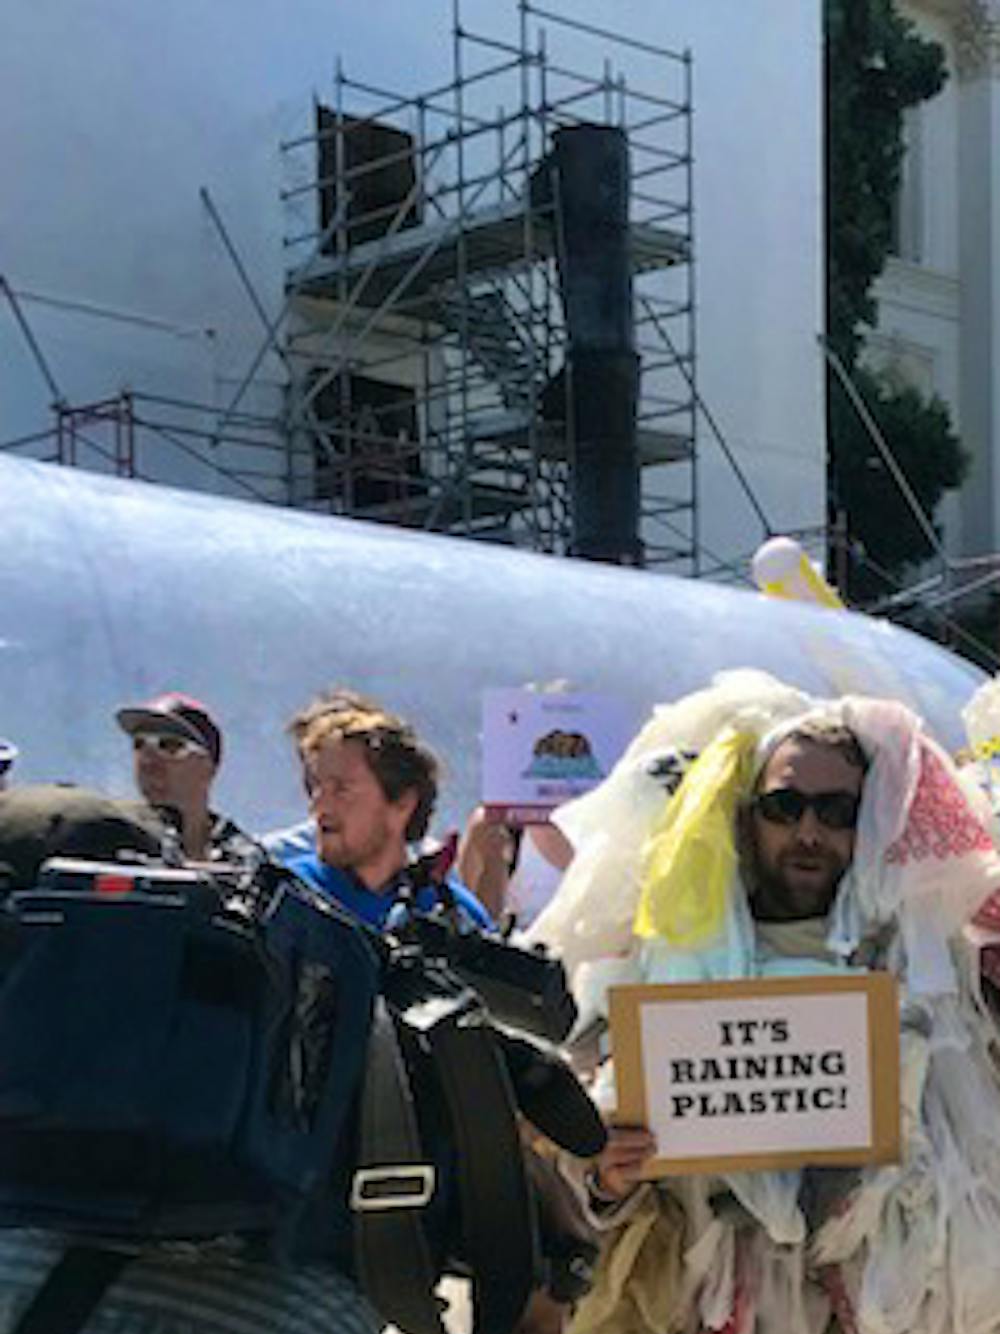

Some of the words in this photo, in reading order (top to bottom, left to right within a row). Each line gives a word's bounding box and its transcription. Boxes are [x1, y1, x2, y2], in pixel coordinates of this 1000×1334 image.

[718, 1019, 790, 1046] IT'S
[670, 1051, 846, 1083] RAINING
[671, 1087, 848, 1118] PLASTIC!
